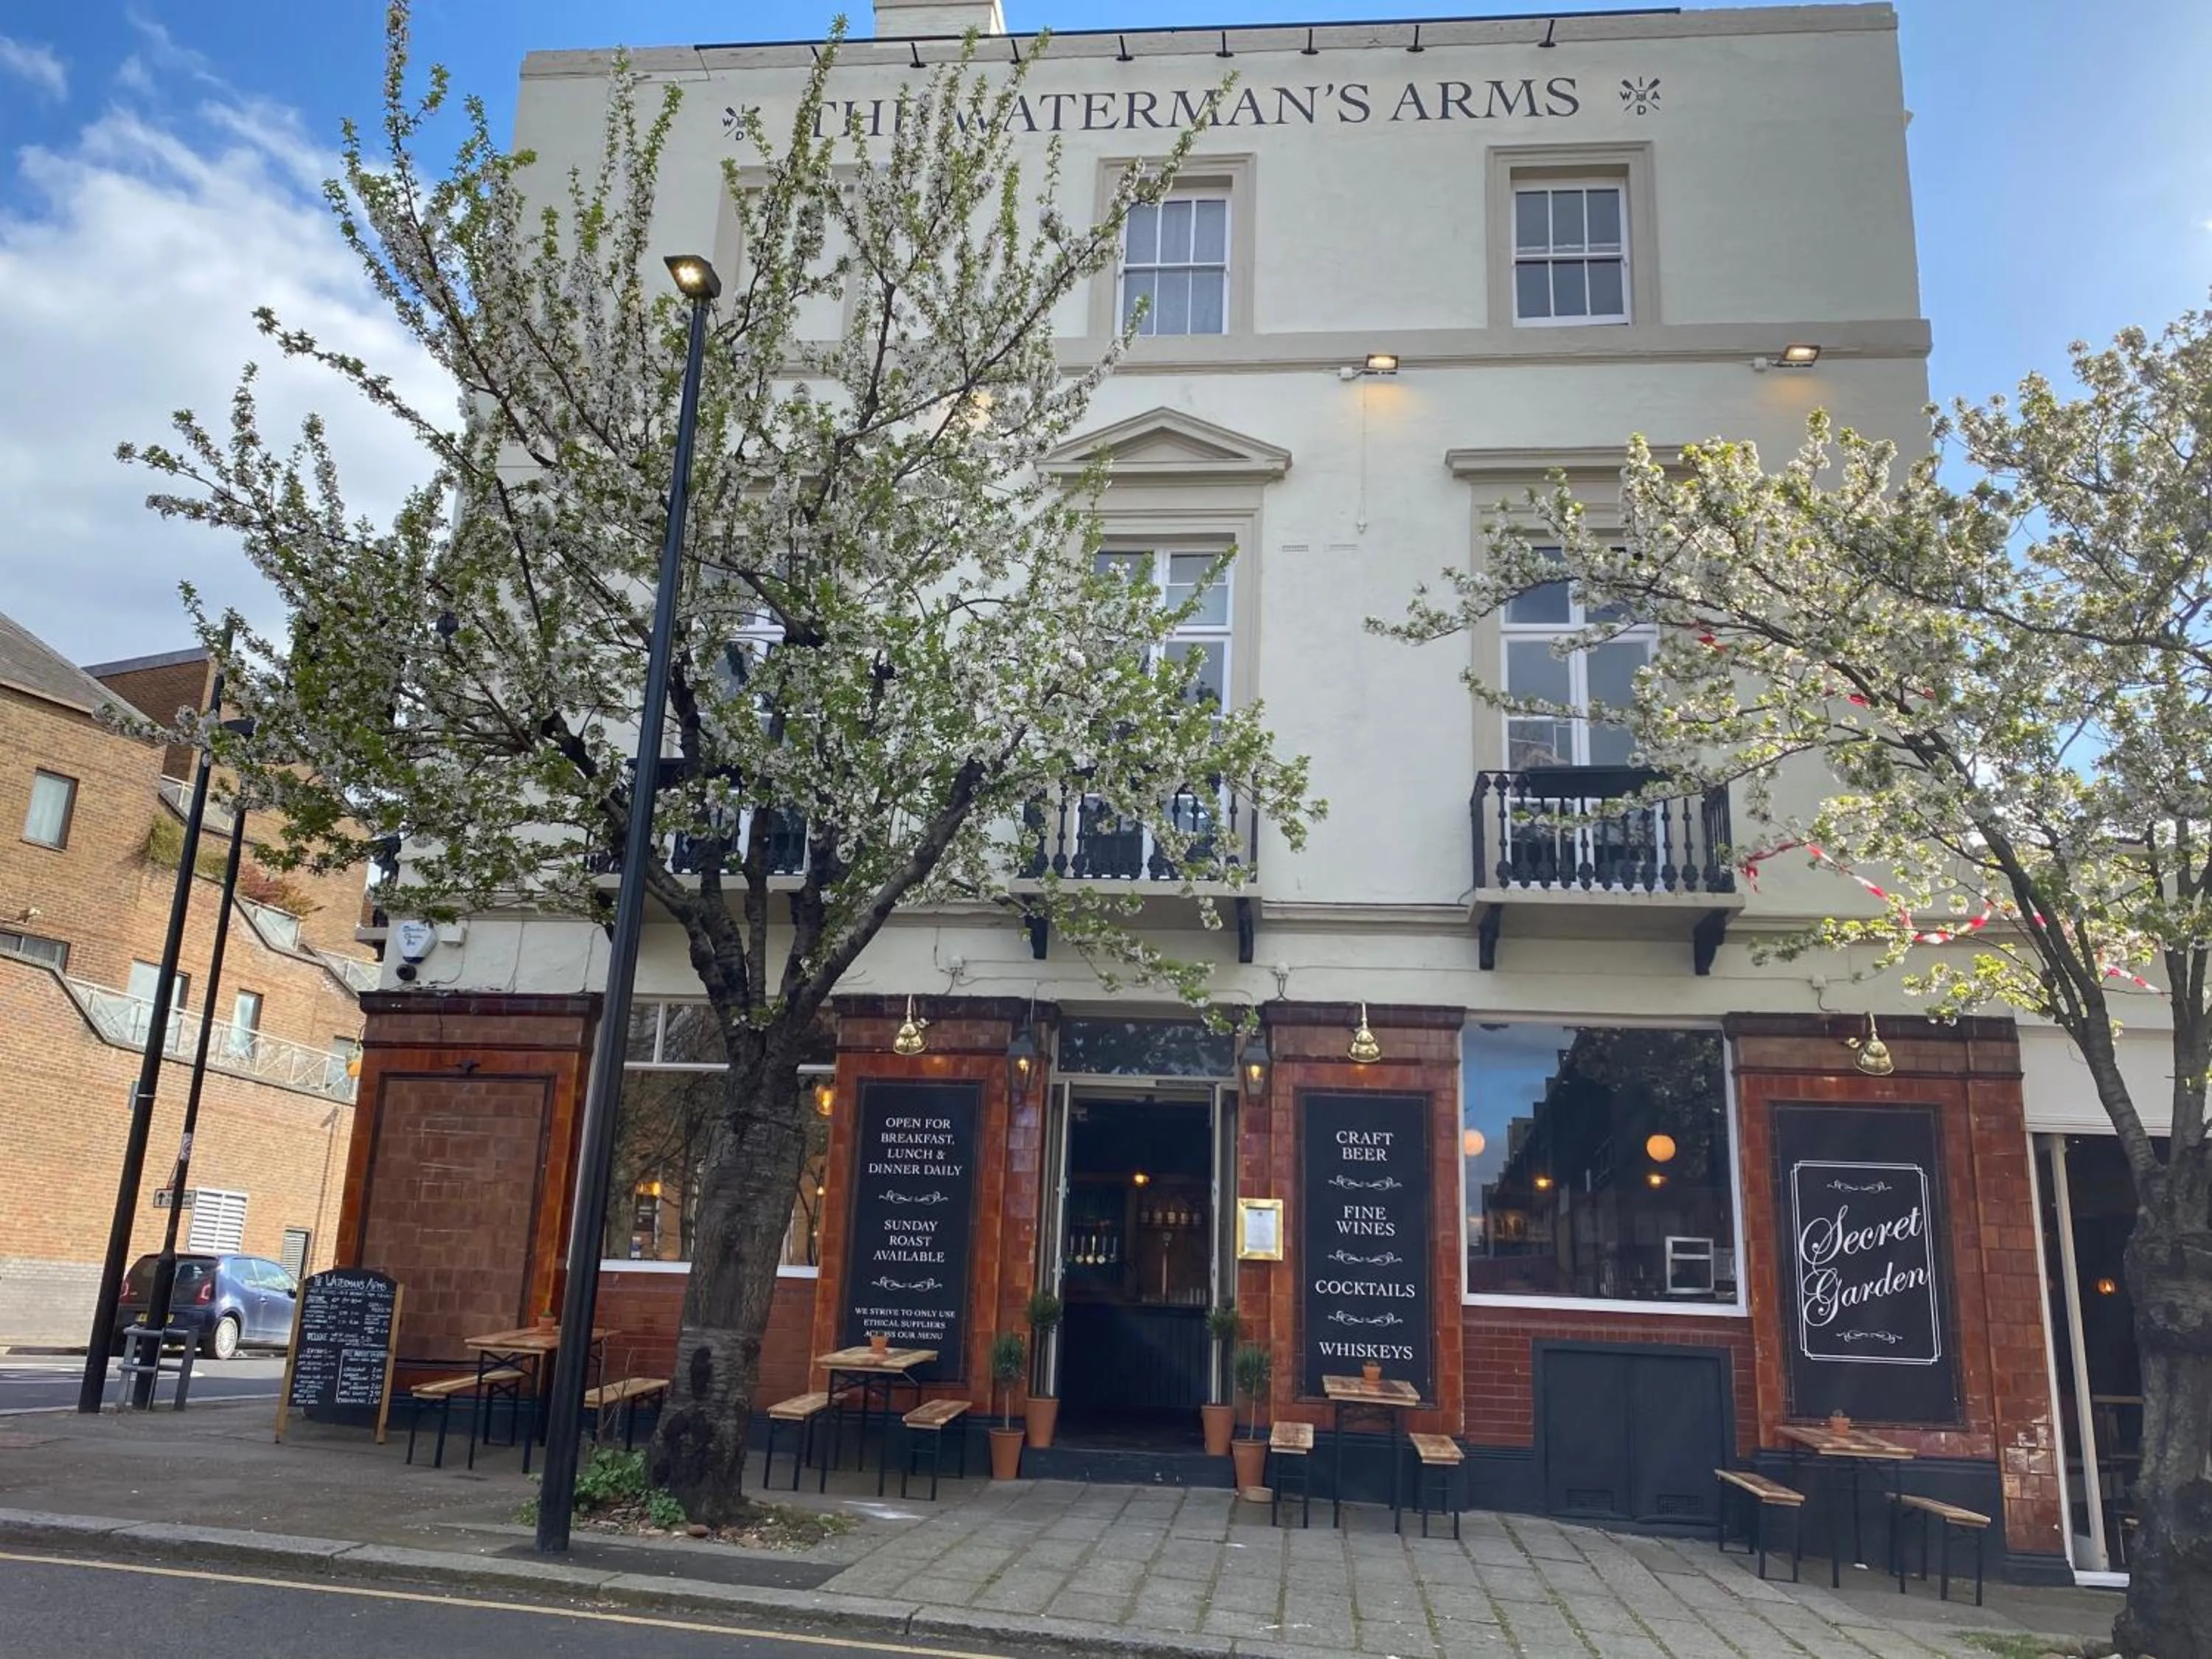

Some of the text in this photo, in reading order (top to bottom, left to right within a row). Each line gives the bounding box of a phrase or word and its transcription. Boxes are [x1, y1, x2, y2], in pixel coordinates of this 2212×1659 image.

[1389, 77, 1579, 121] ARMS
[886, 1117, 951, 1130] OPEN FOR
[880, 1132, 955, 1145] BREAKFAST,
[1336, 1130, 1394, 1146] CRAFT
[887, 1148, 946, 1160] LUNCH &
[1342, 1147, 1388, 1162] BEER
[869, 1163, 962, 1176] DINNER DAILY
[1343, 1206, 1386, 1220] FINE
[884, 1219, 939, 1232] SUNDAY
[1336, 1221, 1396, 1237] WINES
[889, 1235, 933, 1247] ROAST
[1801, 1204, 1924, 1265] Secret
[873, 1250, 945, 1263] AVAILABLE
[1315, 1280, 1416, 1298] COCKTAILS
[1803, 1262, 1929, 1326] Garden
[855, 1307, 868, 1315] WE
[900, 1309, 914, 1317] TO
[914, 1309, 937, 1318] ONLY
[939, 1310, 956, 1318] USE
[863, 1329, 896, 1340] ACSS
[917, 1332, 944, 1340] MENU
[1318, 1341, 1414, 1360] WHISKEYS
